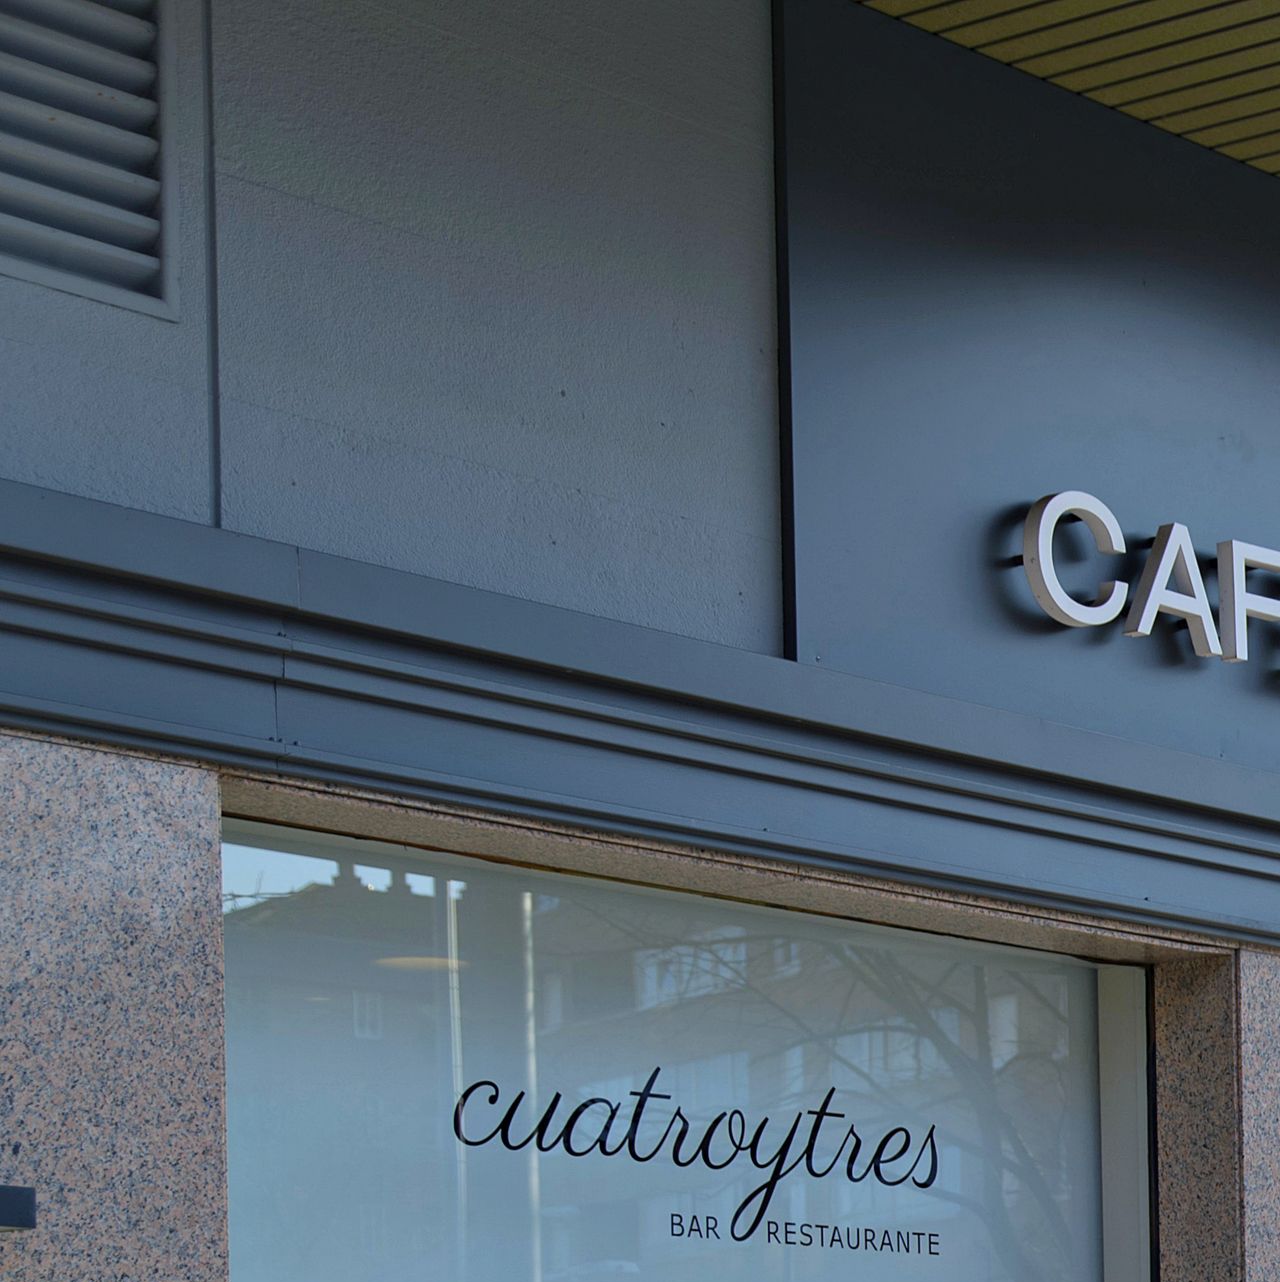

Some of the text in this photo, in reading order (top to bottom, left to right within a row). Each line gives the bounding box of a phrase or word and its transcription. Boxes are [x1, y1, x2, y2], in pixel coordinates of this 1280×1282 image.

[453, 1066, 939, 1242] cuatroytres
[670, 1213, 941, 1256] BAR RESTAURANTE
